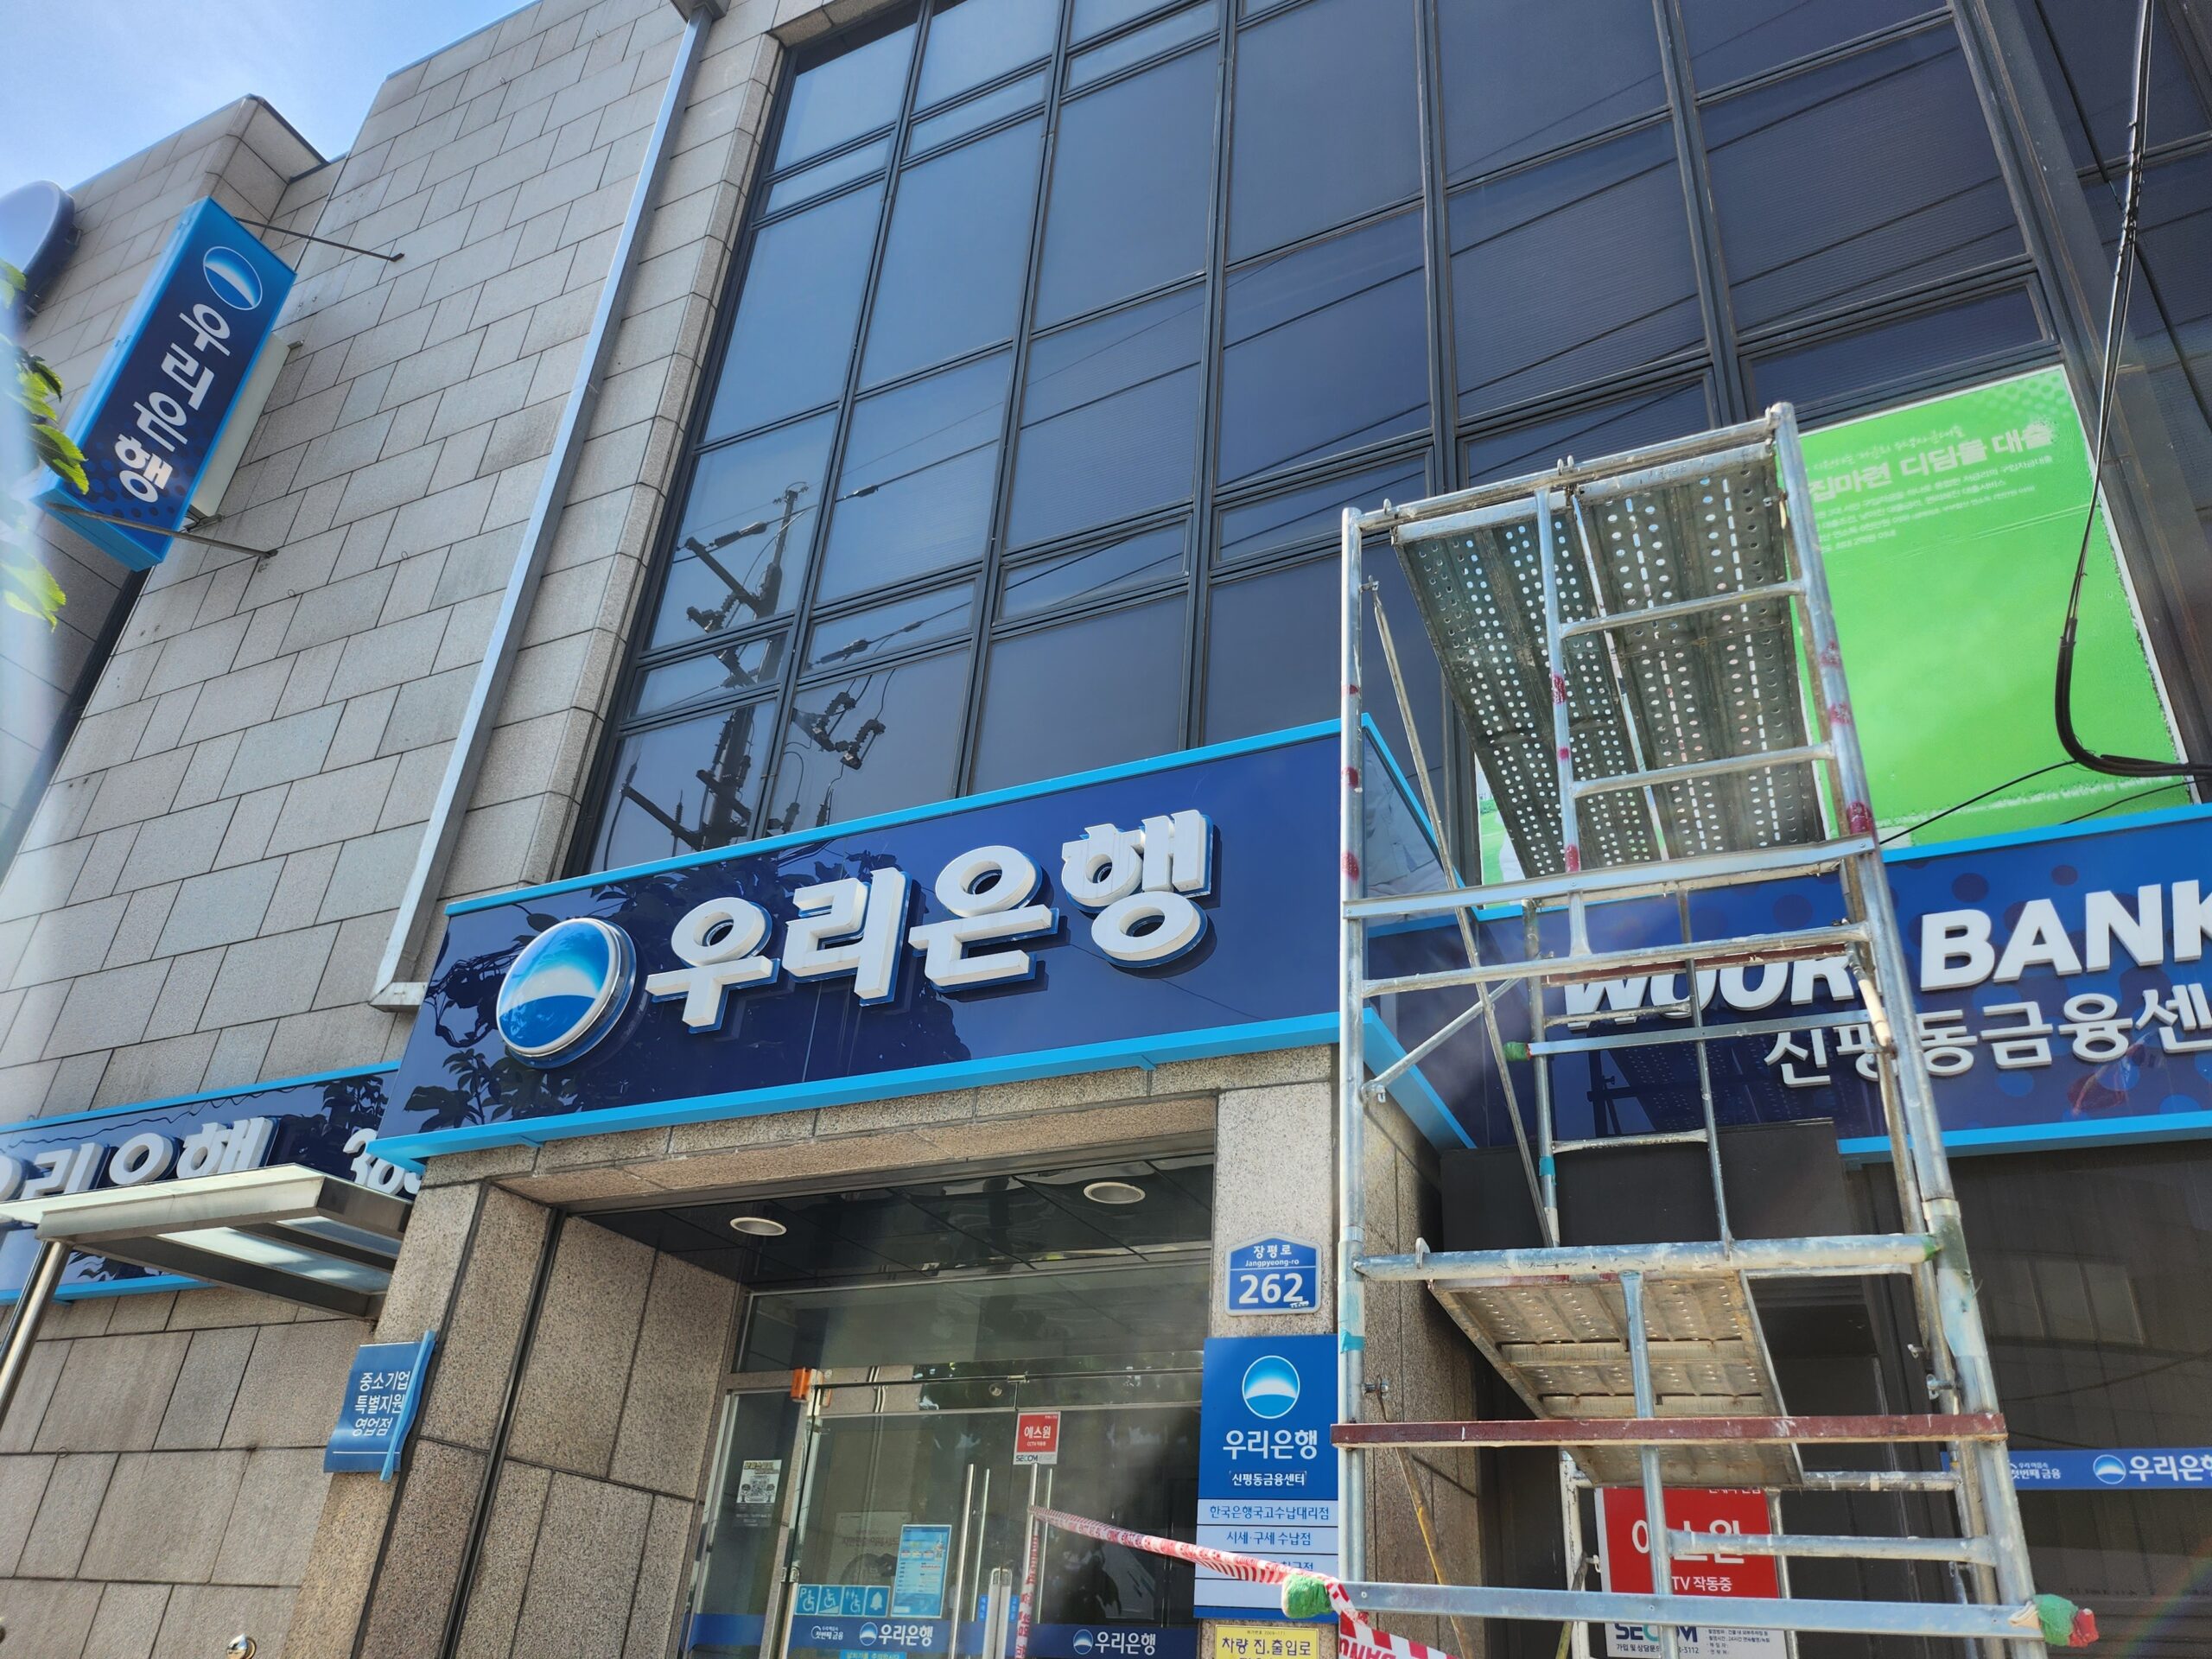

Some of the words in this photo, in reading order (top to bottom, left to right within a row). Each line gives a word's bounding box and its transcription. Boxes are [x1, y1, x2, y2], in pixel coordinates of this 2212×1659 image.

[114, 303, 231, 503] 우리은행
[646, 809, 1211, 1033] 우리은행
[1564, 940, 1884, 1031] WOOR
[1921, 880, 2212, 992] BANK
[1254, 1244, 1292, 1259] 장평로
[1245, 1259, 1300, 1268] Jangpyeong-ro
[1239, 1273, 1303, 1304] 262
[359, 1370, 411, 1392] 중소기업
[354, 1394, 406, 1414] 특별지원
[352, 1417, 394, 1437] 영업점
[1024, 1425, 1052, 1439] 에스원
[1223, 1430, 1318, 1460] 우리은행
[1231, 1472, 1306, 1486] 신평동금융센터
[1210, 1505, 1329, 1521] 한국은행국고수납대리점
[1277, 1532, 1312, 1546] 수납점
[1671, 1576, 1690, 1591] TV
[1693, 1576, 1732, 1592] 작동중
[878, 1624, 933, 1647] 우리은행
[1095, 1631, 1156, 1656] 우리은행
[1222, 1637, 1249, 1655] 차량
